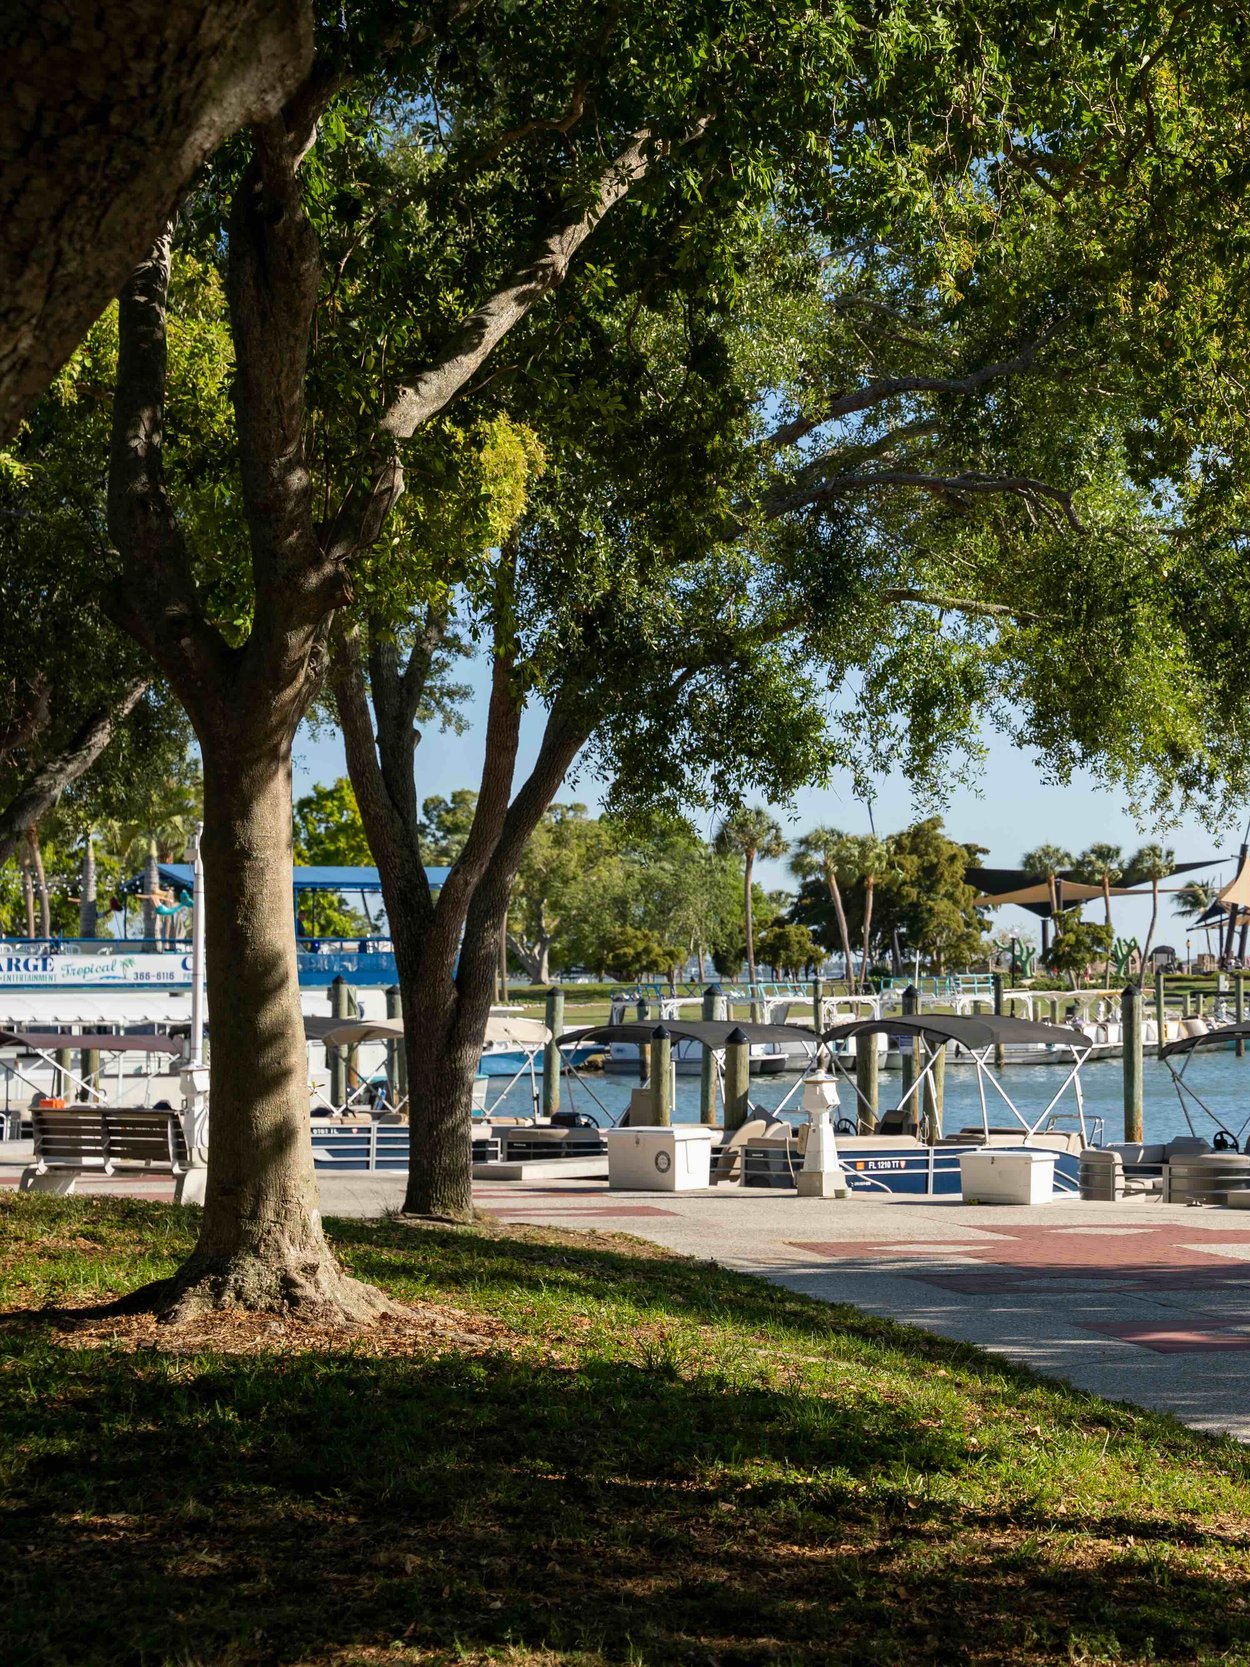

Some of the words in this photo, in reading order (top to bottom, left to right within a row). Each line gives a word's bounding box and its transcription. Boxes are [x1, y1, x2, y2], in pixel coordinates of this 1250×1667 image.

[0, 957, 55, 972] RGE
[61, 958, 117, 979] Tropical
[3, 973, 57, 982] ENTERTAINMENT
[868, 1161, 877, 1169] FL
[878, 1161, 891, 1169] 1210
[891, 1160, 900, 1168] TT
